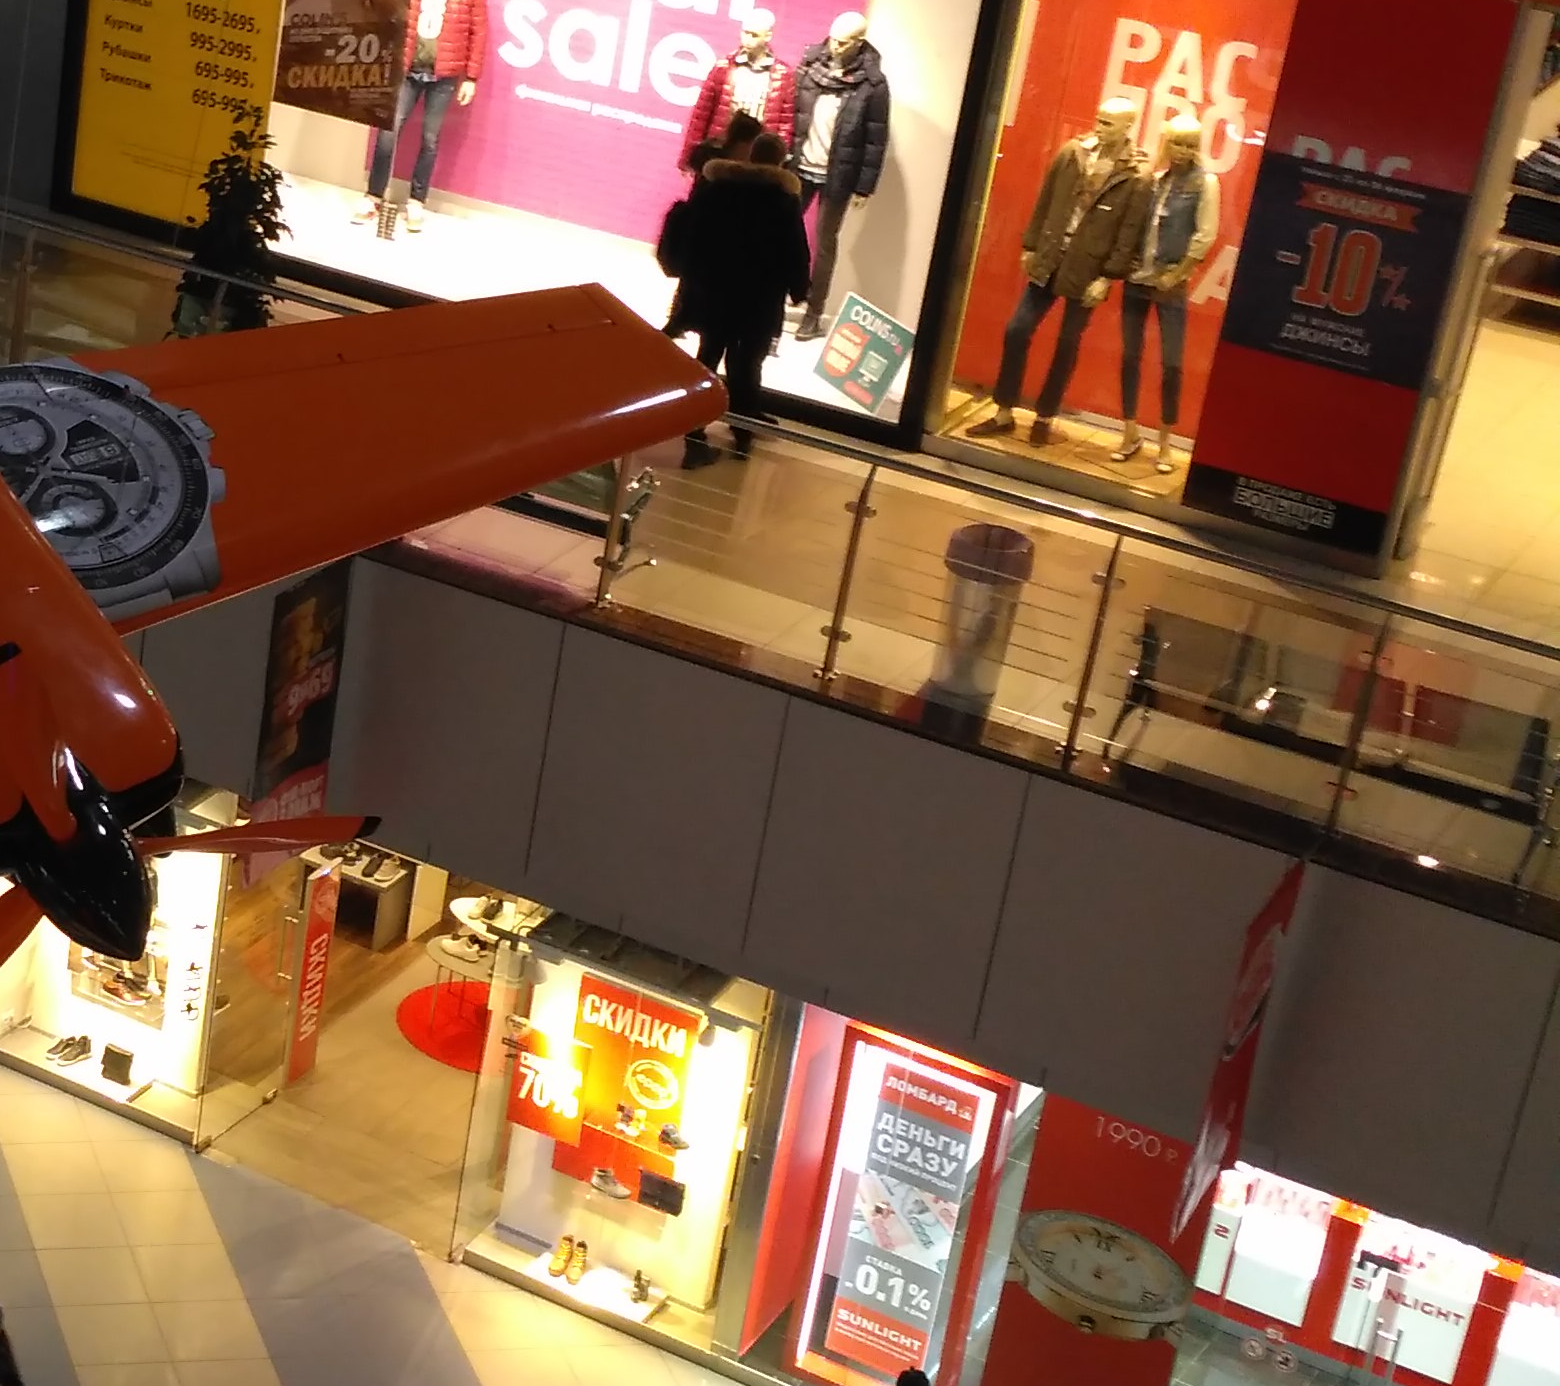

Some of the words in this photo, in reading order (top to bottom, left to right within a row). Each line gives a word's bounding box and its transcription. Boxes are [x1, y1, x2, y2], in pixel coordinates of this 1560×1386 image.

[103, 13, 144, 34] Куртки
[287, 63, 392, 92] СКИДКА!
[582, 993, 688, 1059] СКИДКИ
[886, 1075, 959, 1116] ЛОМБАРД
[876, 1133, 959, 1177] СРАЗУ
[877, 1112, 967, 1160] ДЕНЬГИ
[1095, 1116, 1162, 1158] 1990
[1351, 1275, 1466, 1328] SNLIGHT
[837, 1307, 923, 1351] SUNLIGHT
